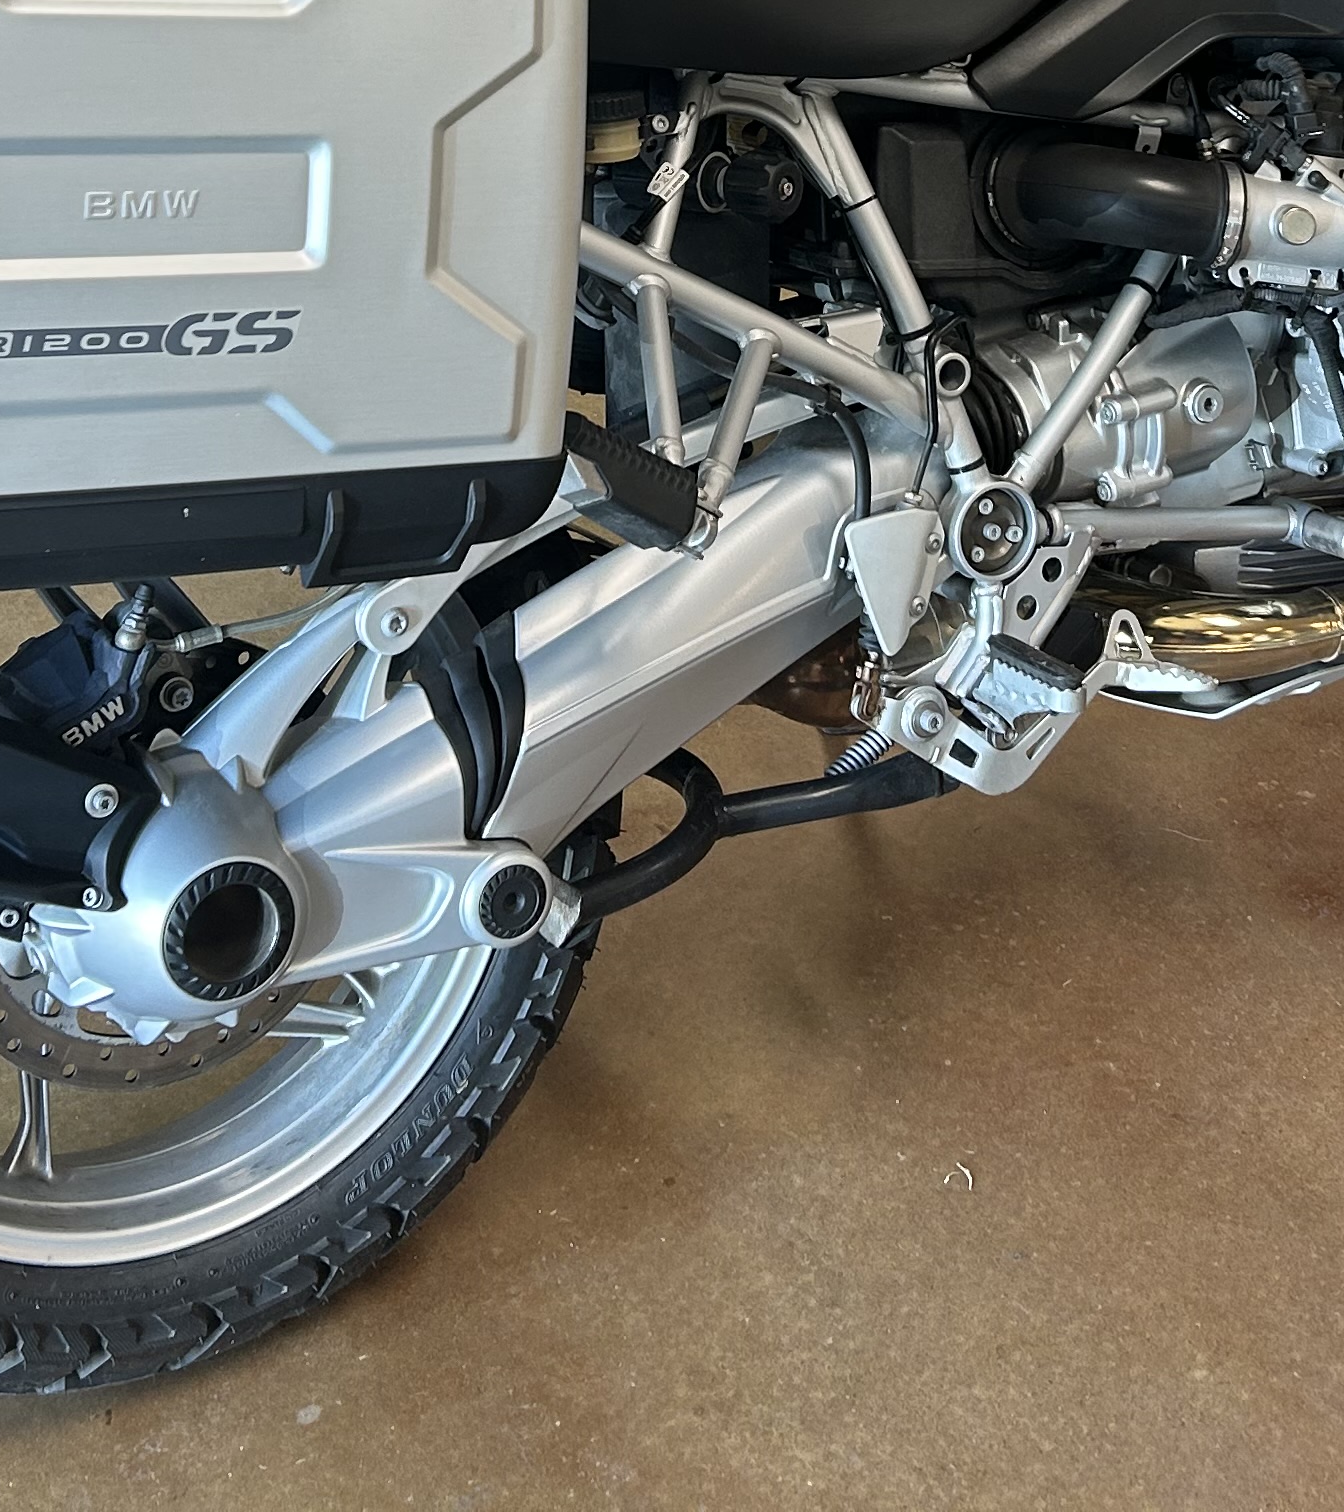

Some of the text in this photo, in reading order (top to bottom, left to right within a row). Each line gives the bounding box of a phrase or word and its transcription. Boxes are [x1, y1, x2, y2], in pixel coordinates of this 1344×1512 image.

[83, 189, 199, 220] BMW
[62, 696, 125, 747] BMW
[345, 1053, 474, 1206] DUNLOP
